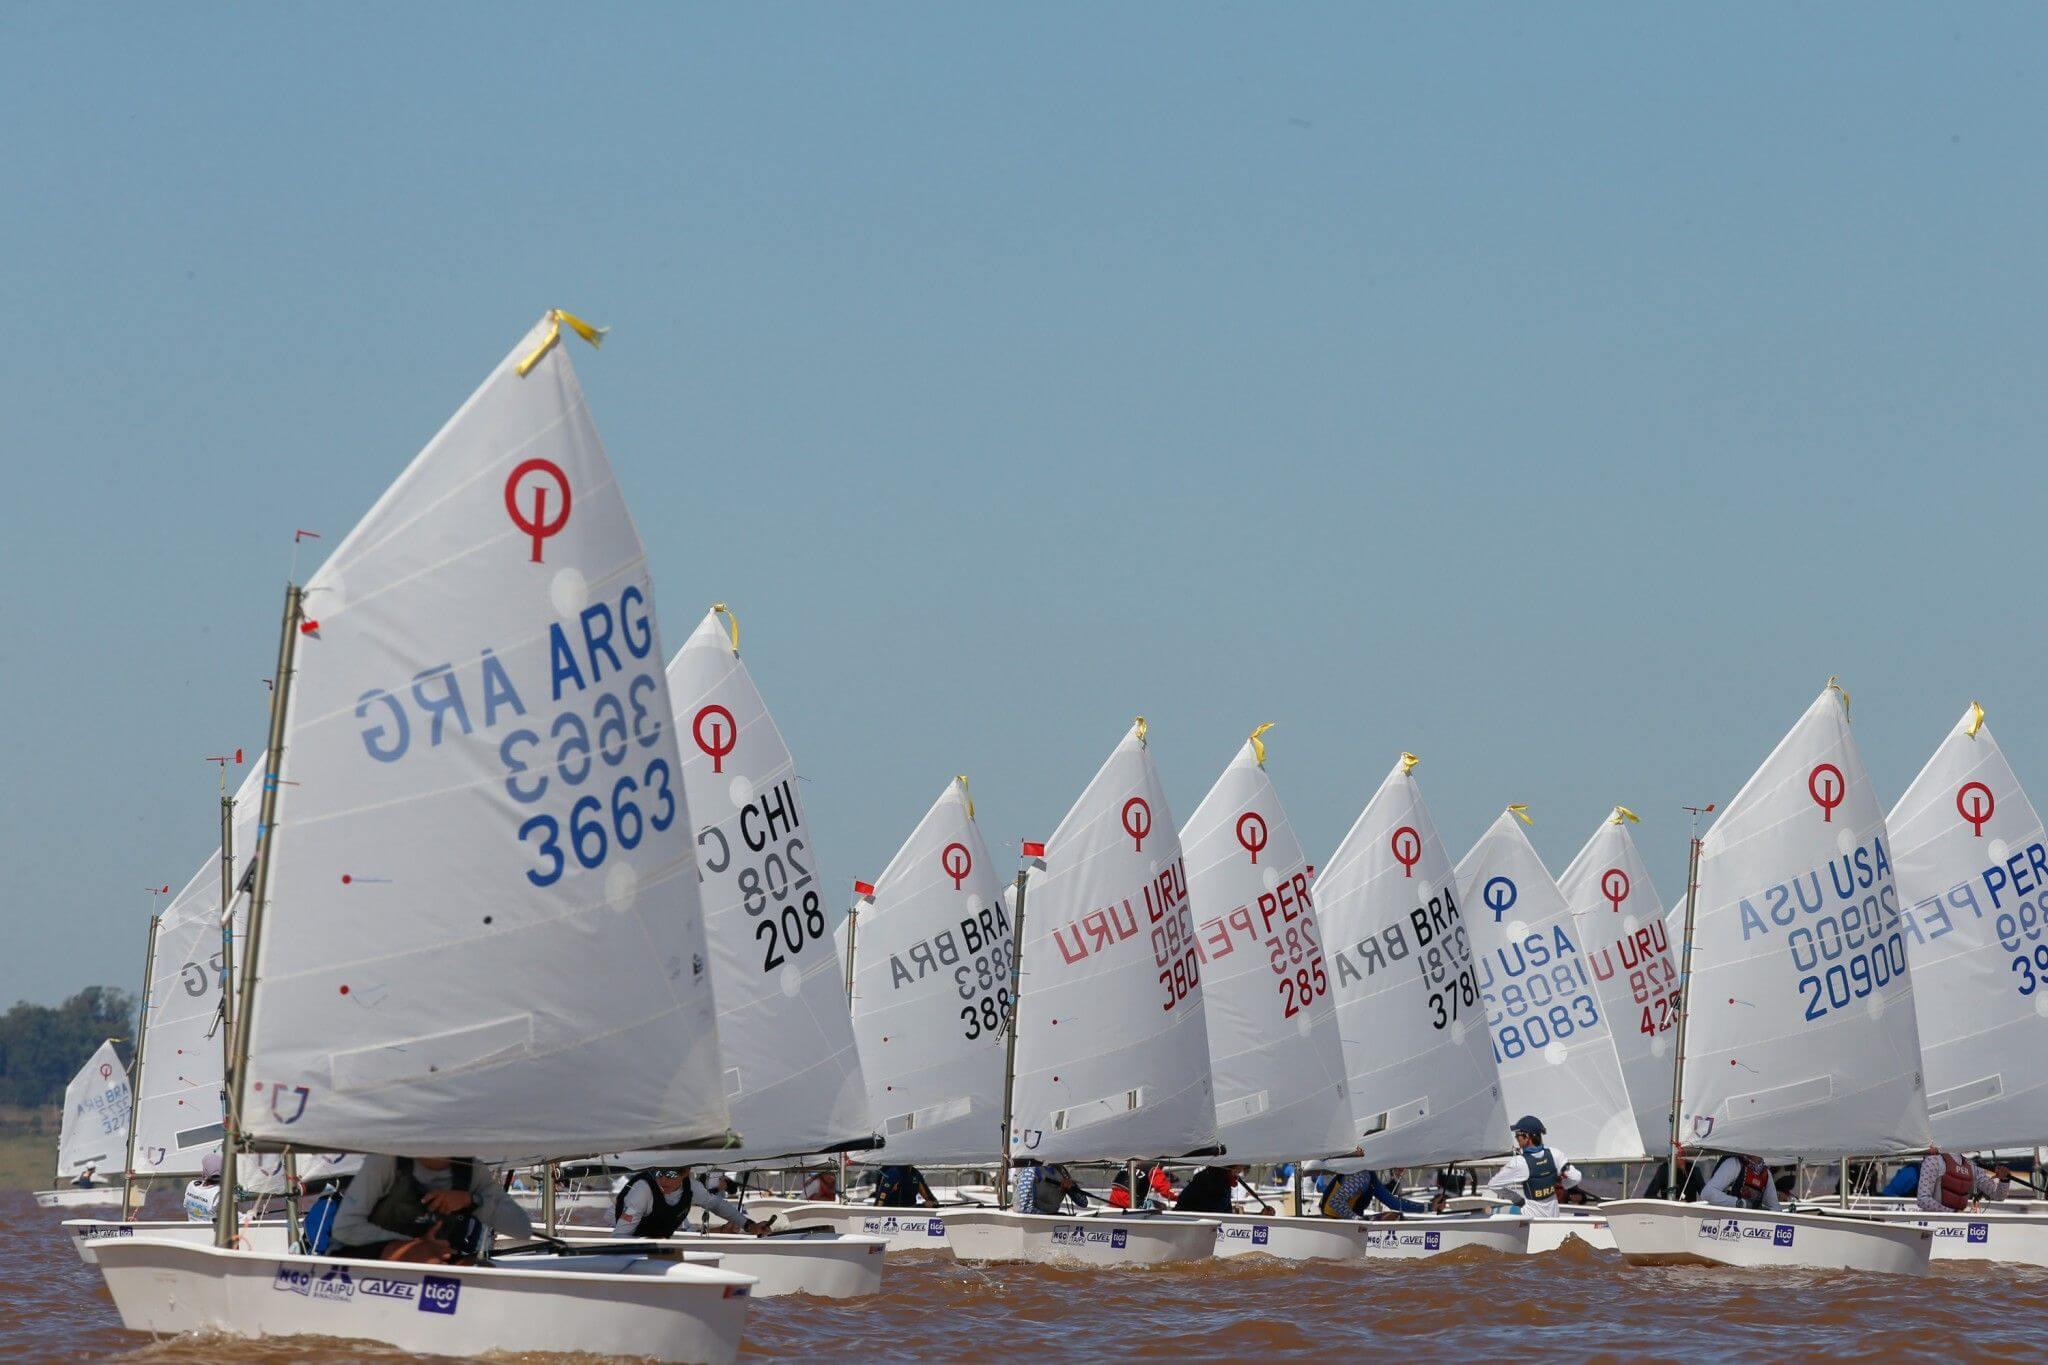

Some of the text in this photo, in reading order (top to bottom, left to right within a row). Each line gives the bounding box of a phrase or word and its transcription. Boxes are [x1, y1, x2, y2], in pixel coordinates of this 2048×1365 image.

[550, 586, 652, 701] ARG
[518, 758, 676, 888] 3663
[740, 780, 800, 852] CHI
[1143, 857, 1187, 924] URU
[1829, 837, 1891, 900] USA
[1981, 843, 2048, 909] PER
[756, 891, 825, 972] 208
[960, 901, 1009, 955] BRA
[1257, 872, 1312, 933] PER
[1410, 886, 1460, 947] BRA
[1496, 925, 1576, 977] USA
[1616, 919, 1668, 970] URU
[1159, 947, 1199, 1011] 380
[1278, 955, 1327, 1019] 285
[1428, 963, 1480, 1030] 3781
[1799, 932, 1906, 1022] 20900
[960, 987, 1011, 1040] 388
[1534, 1186, 1556, 1198] BRA
[1776, 1229, 1792, 1240] tigo
[1968, 1226, 1986, 1237] tigo
[315, 1279, 355, 1297] ITAIPU
[424, 1283, 456, 1302] tigo
